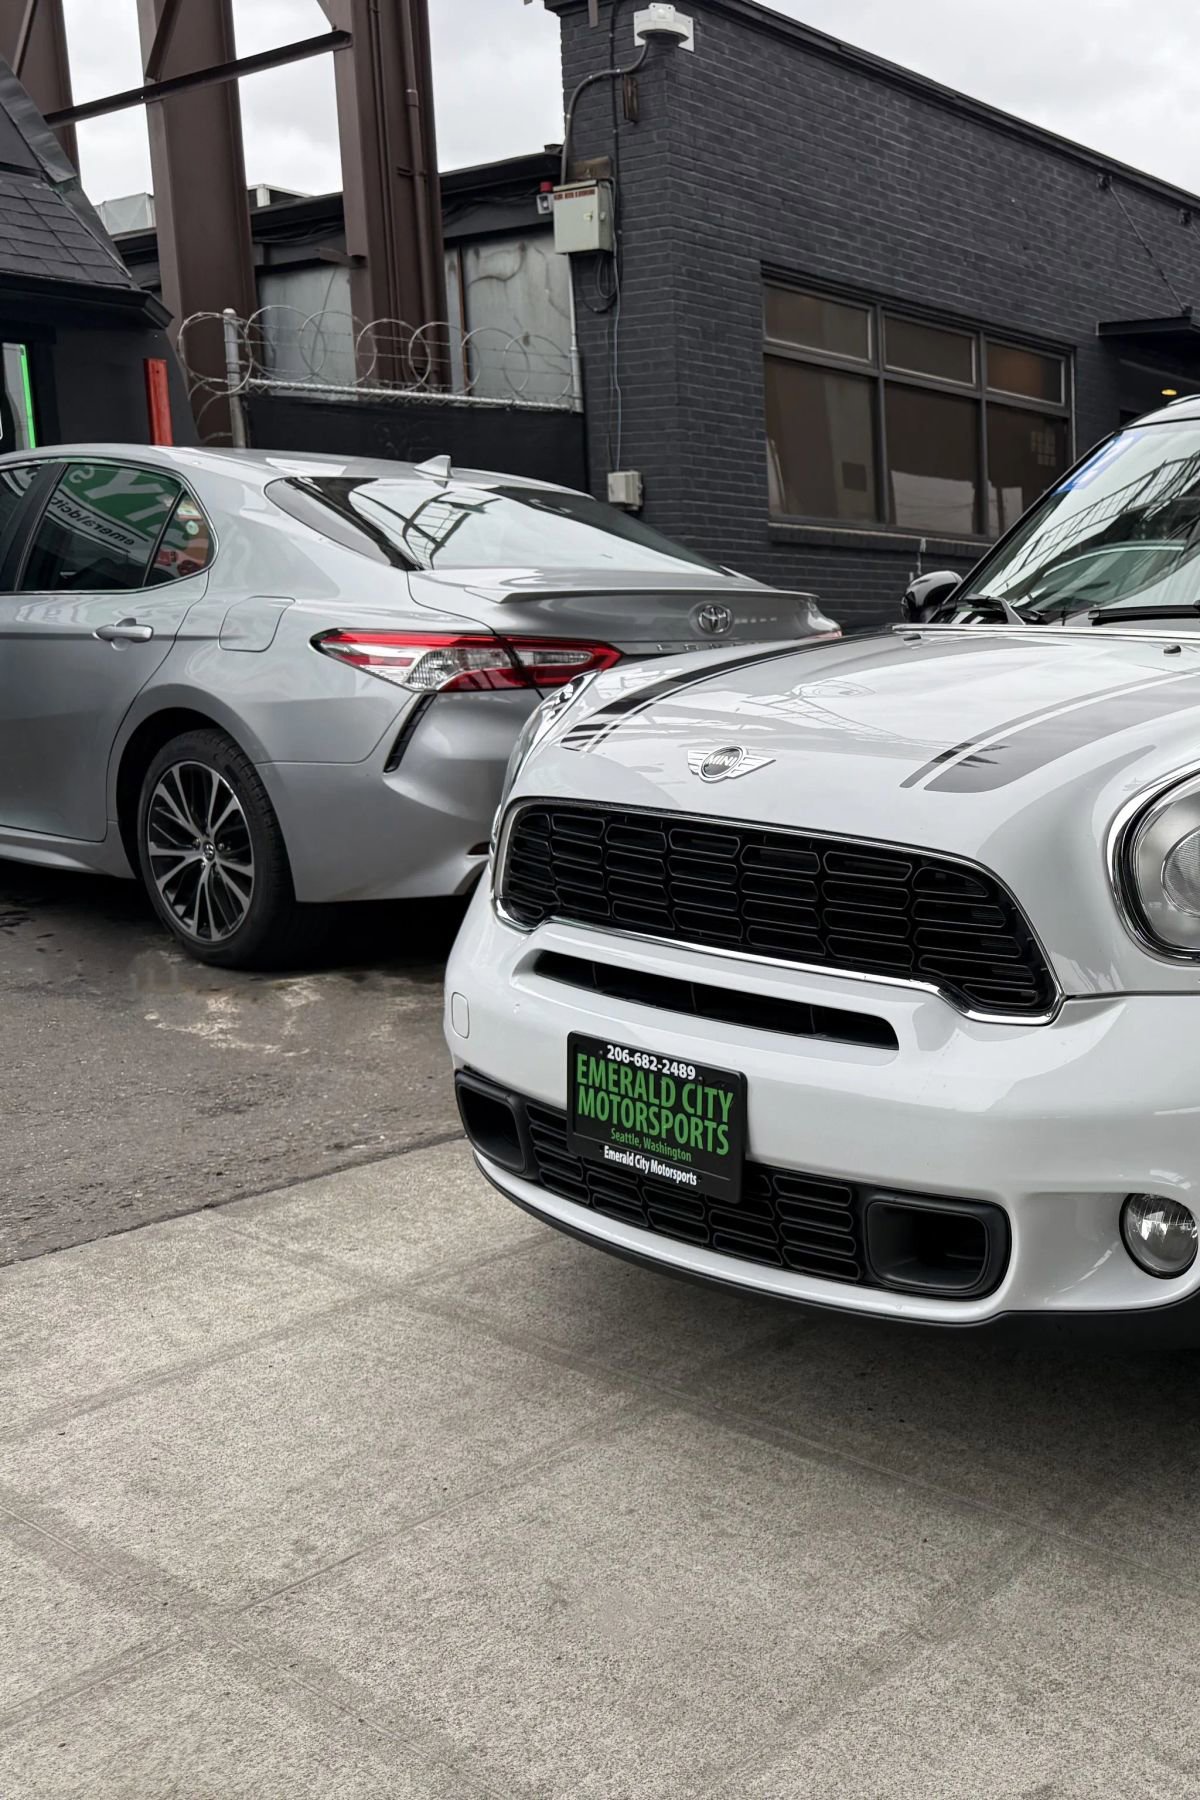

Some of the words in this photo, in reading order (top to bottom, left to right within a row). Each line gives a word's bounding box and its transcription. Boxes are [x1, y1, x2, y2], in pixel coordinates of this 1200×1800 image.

[706, 755, 738, 766] MINI
[607, 1045, 696, 1080] 206-682-2489
[577, 1053, 676, 1108] EMERALD
[682, 1083, 734, 1123] CITY
[578, 1085, 729, 1156] MOTORSPORTS
[611, 1128, 642, 1150] Seattle,
[643, 1137, 692, 1163] Washington
[604, 1146, 633, 1167] Emerald
[635, 1155, 650, 1174] City
[650, 1161, 697, 1186] Motorsports
